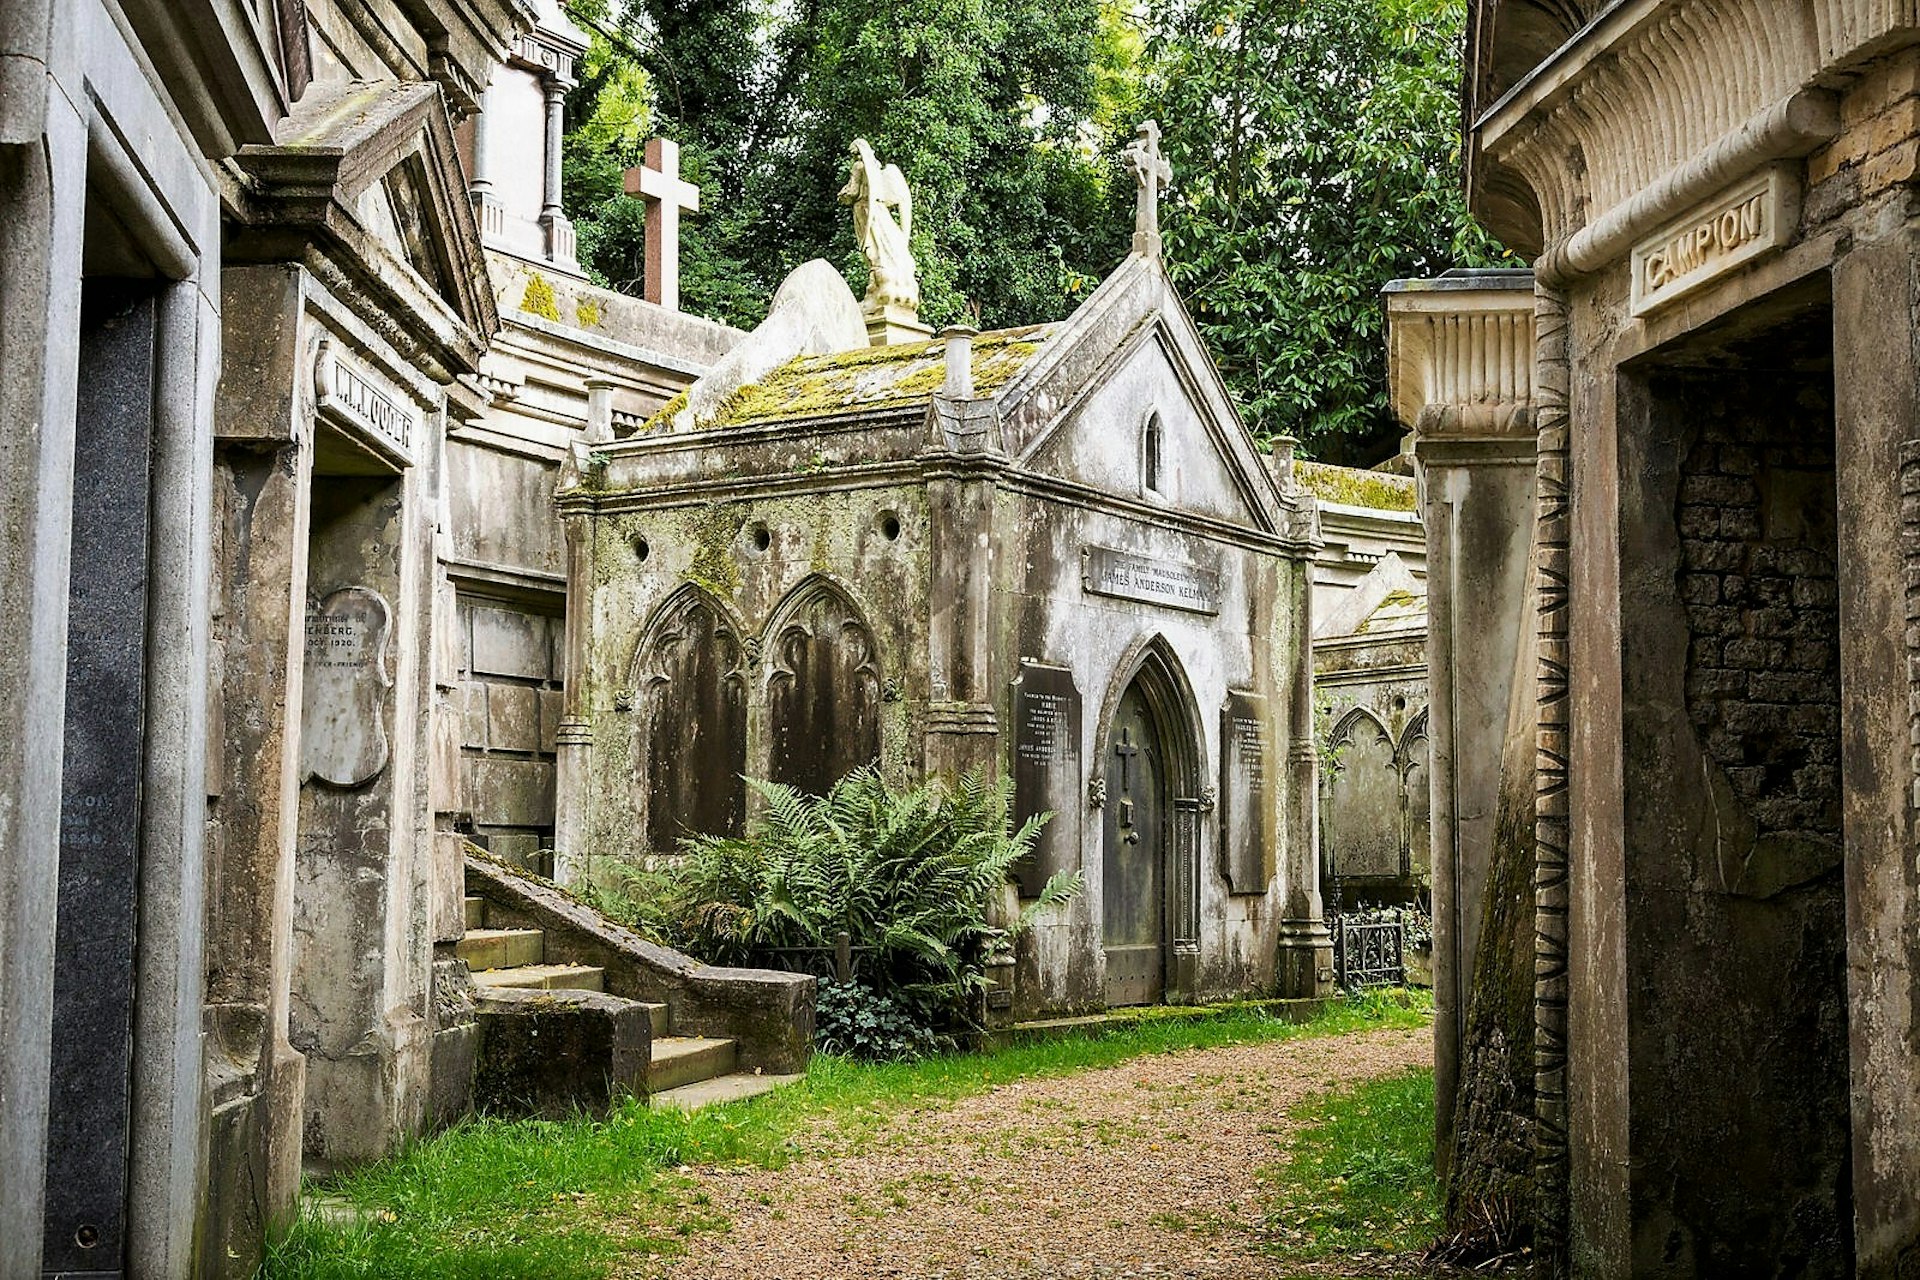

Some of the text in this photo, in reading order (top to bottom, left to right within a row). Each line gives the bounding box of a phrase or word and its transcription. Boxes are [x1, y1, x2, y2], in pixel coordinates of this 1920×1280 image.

[1646, 197, 1761, 289] CAMPION
[1102, 571, 1130, 586] JAMES
[1134, 578, 1176, 596] ANDERSON
